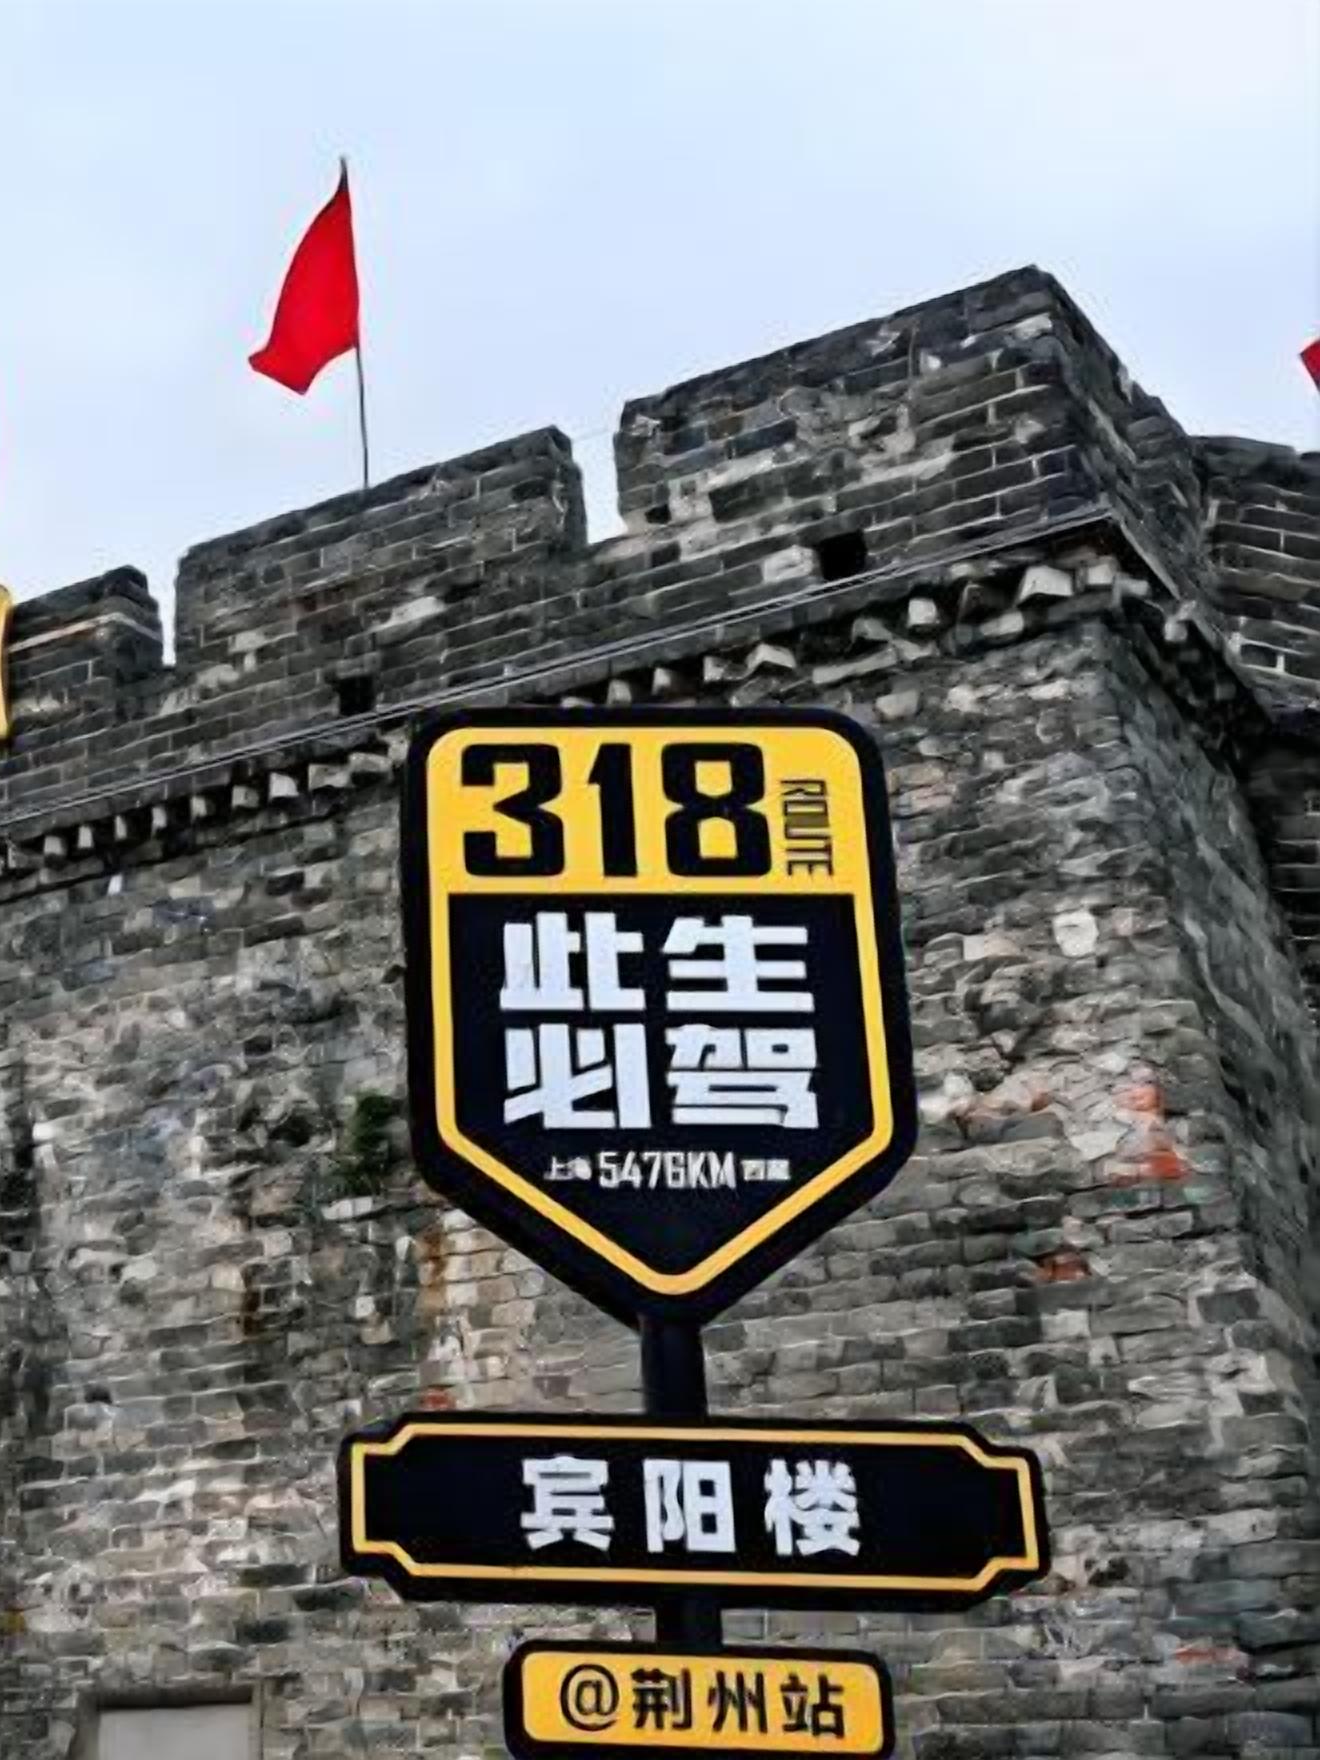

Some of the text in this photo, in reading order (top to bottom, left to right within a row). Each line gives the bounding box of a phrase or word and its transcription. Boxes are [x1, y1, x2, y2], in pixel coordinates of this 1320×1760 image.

[460, 741, 773, 878] 318
[780, 779, 833, 876] ROUTE
[499, 911, 815, 1013] 此生
[503, 1022, 819, 1129] 必驾
[598, 1151, 737, 1189] 5476KM
[519, 1456, 862, 1557] 宾阳楼
[559, 1663, 846, 1739] @荆州站
